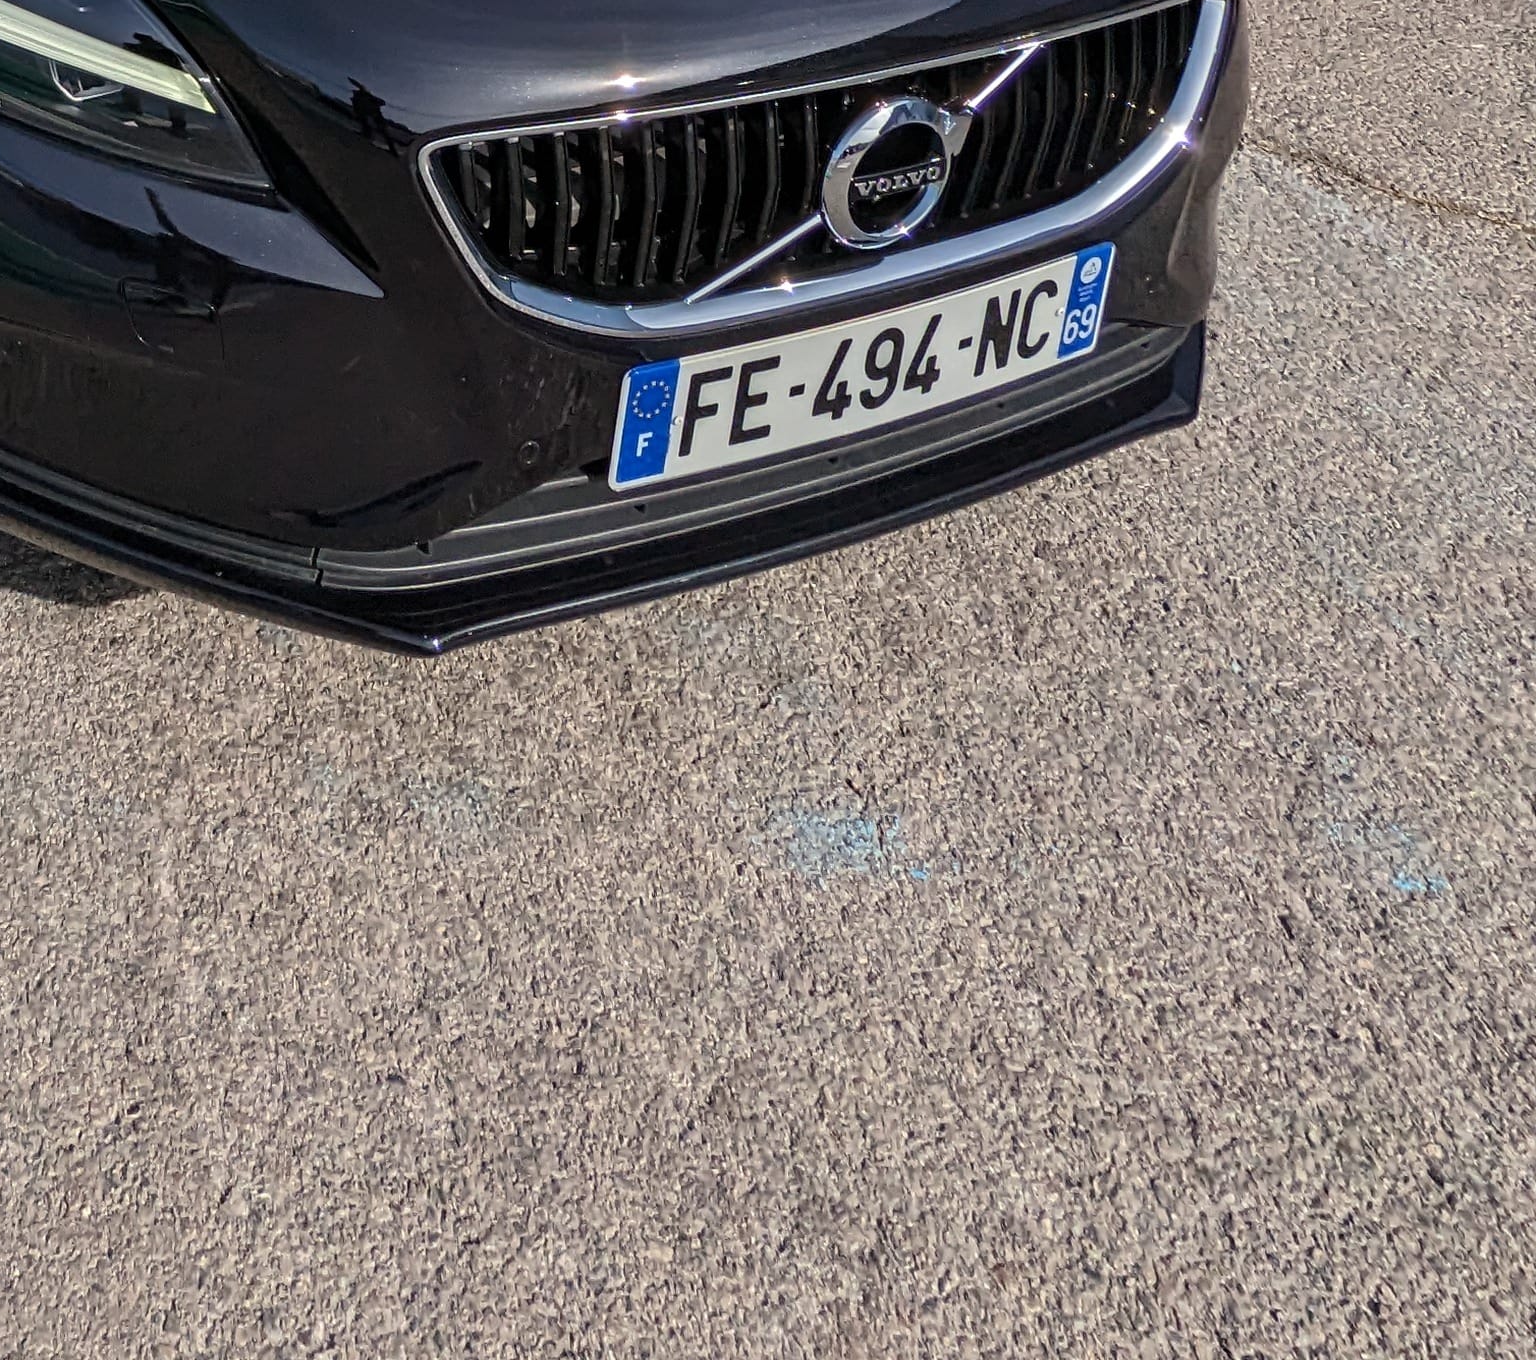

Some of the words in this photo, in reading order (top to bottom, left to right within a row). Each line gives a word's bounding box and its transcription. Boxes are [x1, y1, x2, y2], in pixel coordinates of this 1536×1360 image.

[854, 166, 941, 197] VOLVO
[1063, 303, 1097, 345] 69
[678, 280, 1058, 457] FE-494-NC
[636, 432, 653, 457] F
